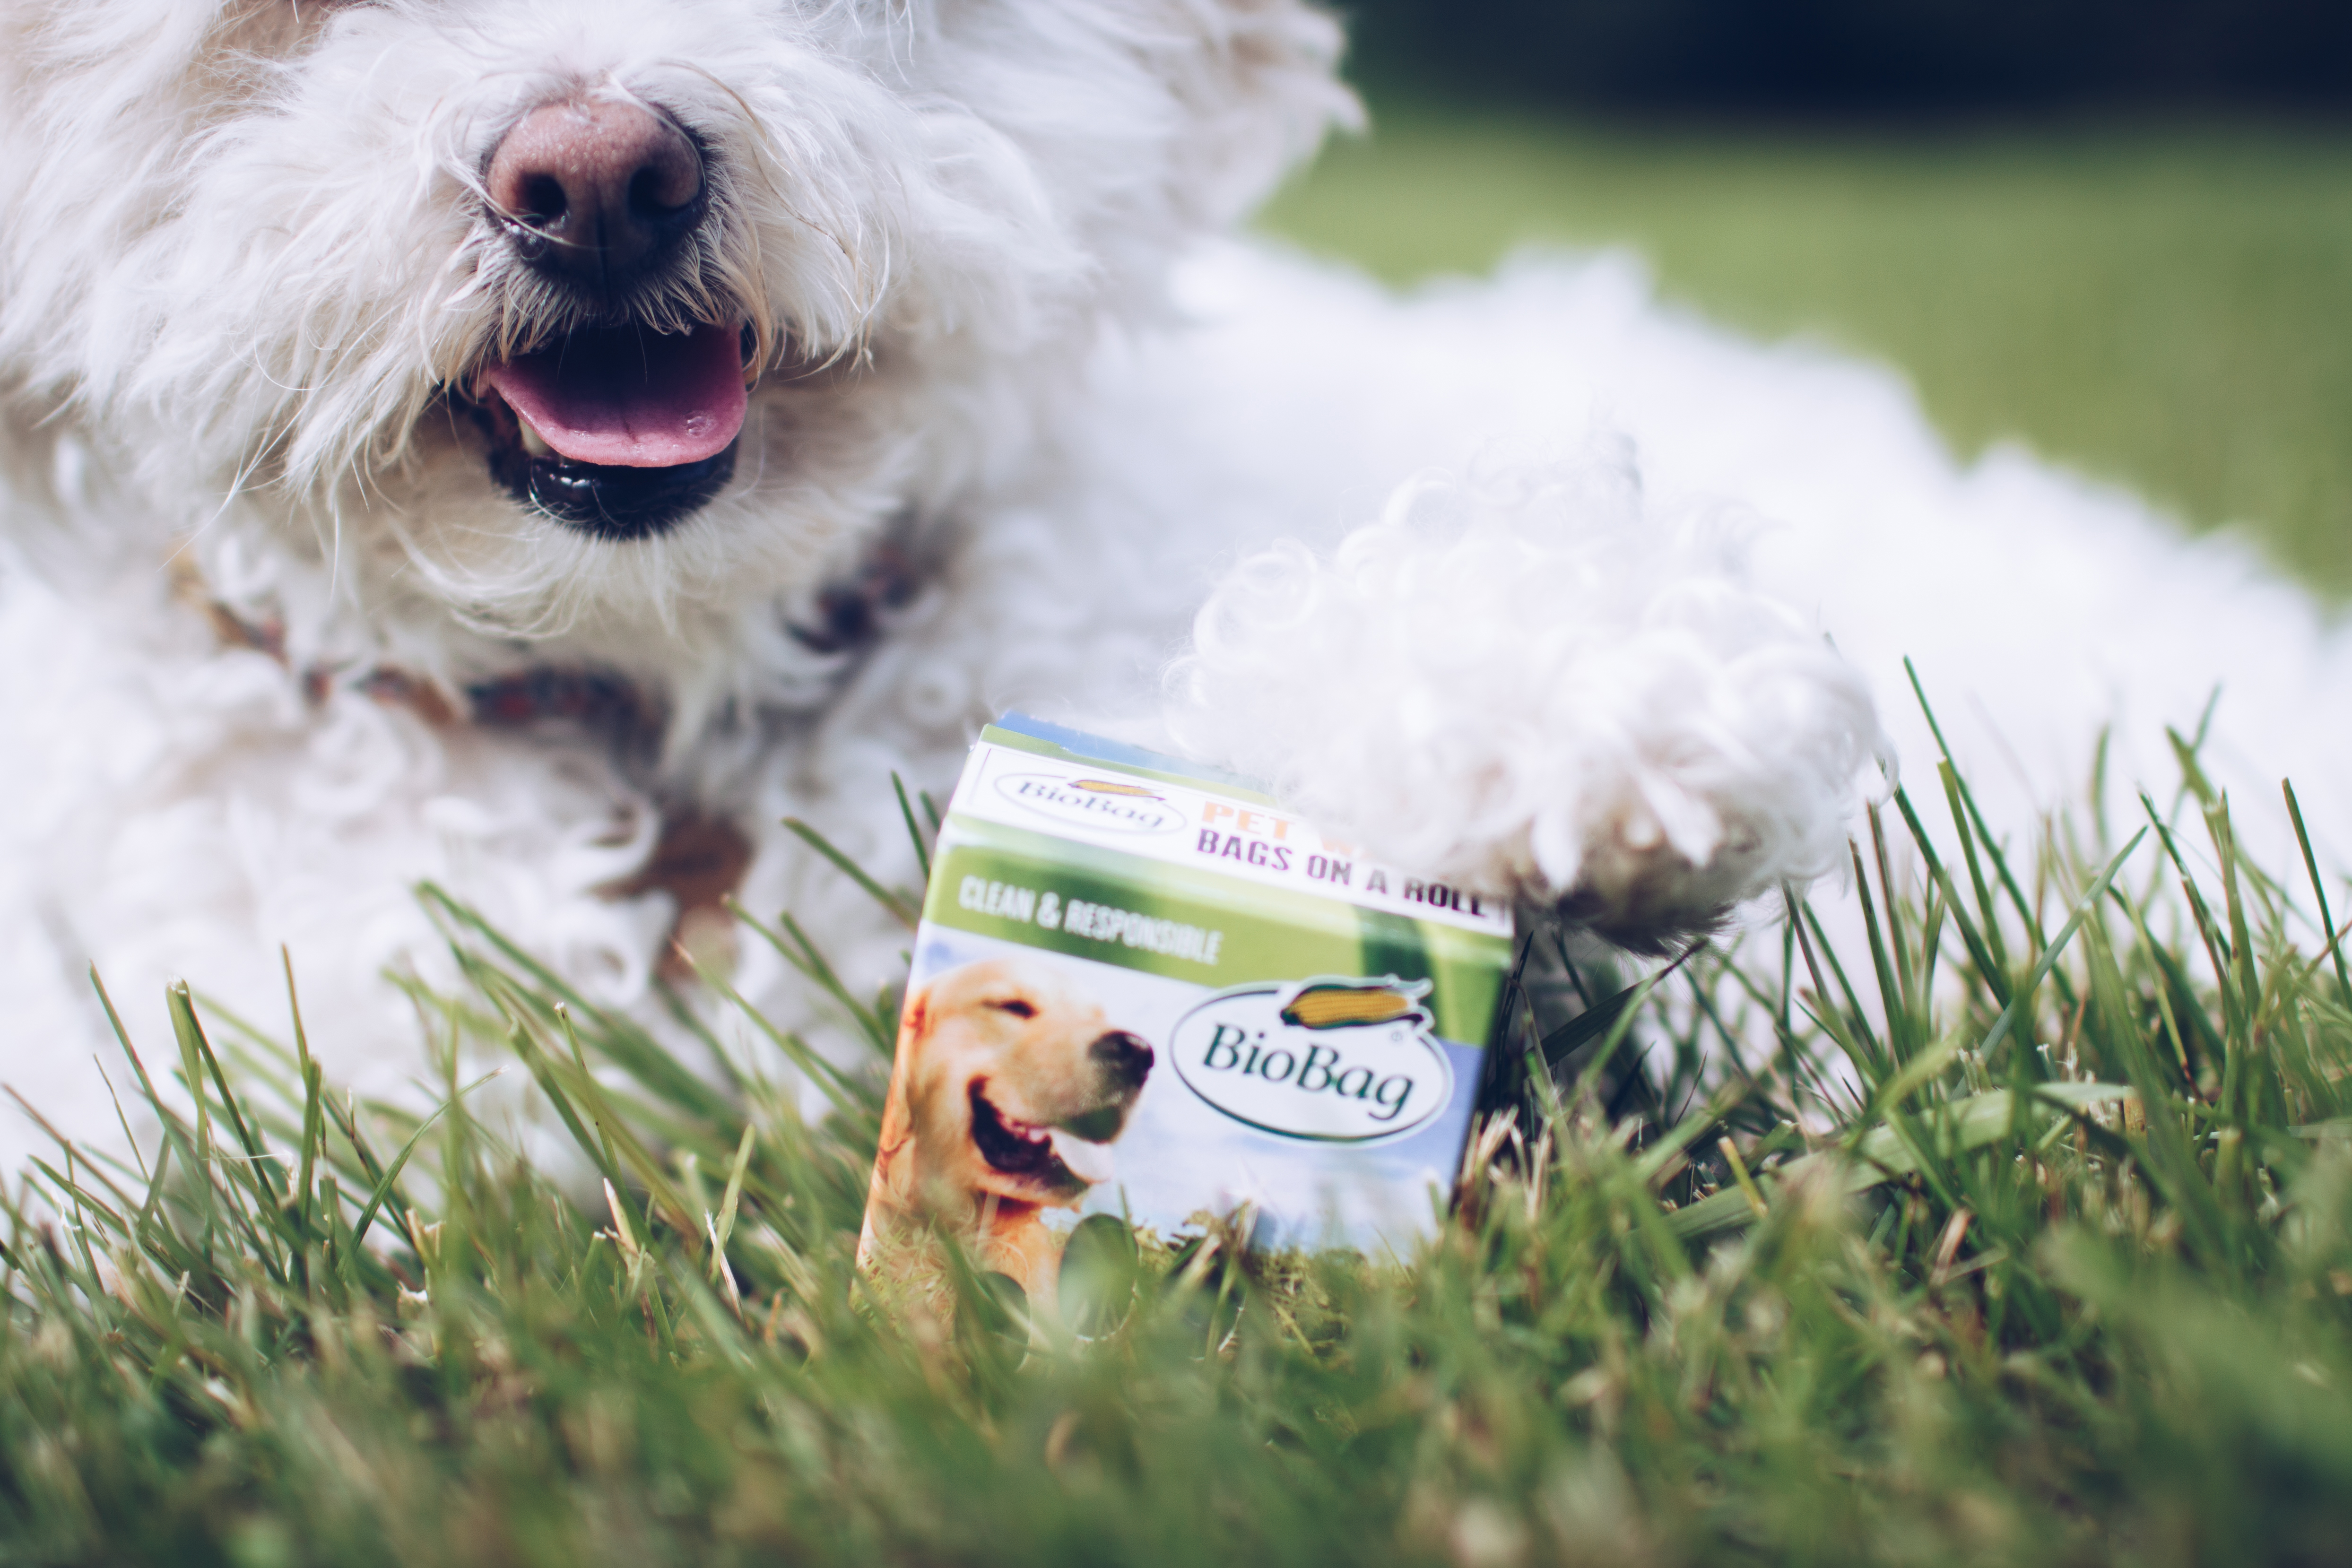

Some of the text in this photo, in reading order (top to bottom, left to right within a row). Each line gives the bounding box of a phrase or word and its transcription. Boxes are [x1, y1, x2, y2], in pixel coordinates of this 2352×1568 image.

[1018, 781, 1164, 828] BioBag
[1201, 801, 1295, 840] PET
[1197, 828, 1293, 871] BAGS
[1307, 855, 1352, 885] ON
[1365, 869, 1388, 895] A
[1404, 877, 1487, 918] ROLL
[959, 875, 1223, 965] CLEAN & RESPONSIBLE
[1203, 1023, 1414, 1121] BioBag
